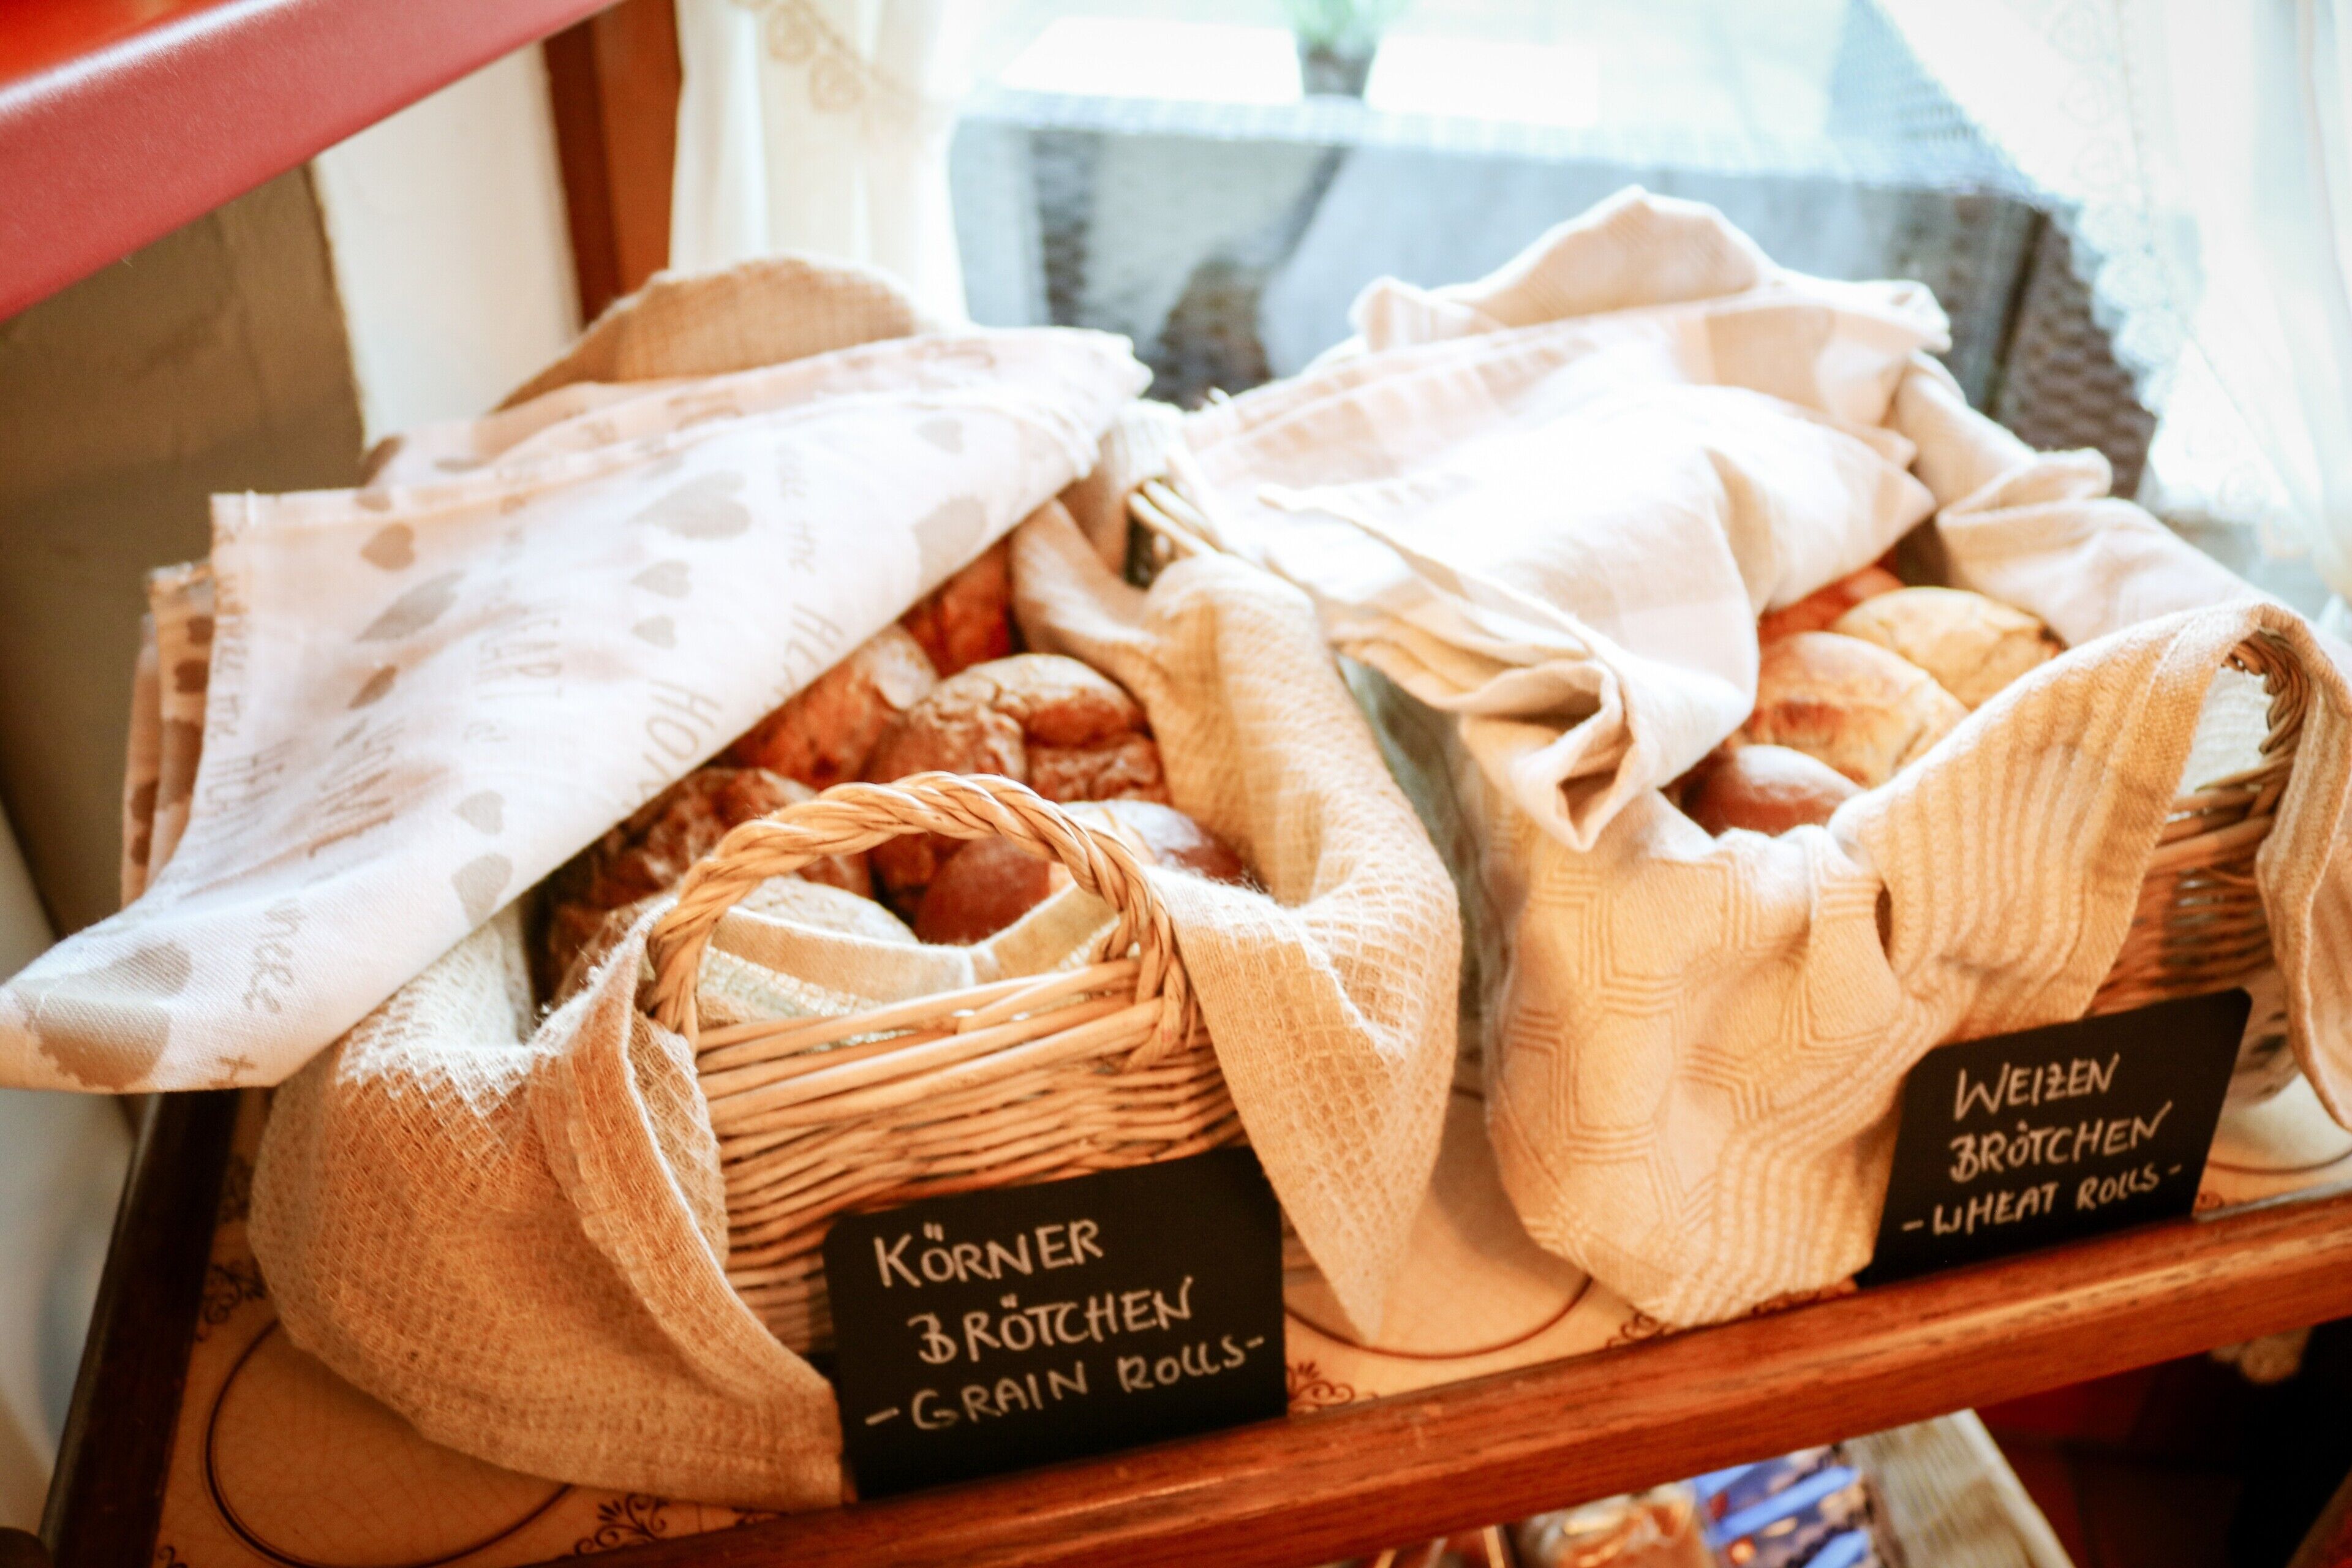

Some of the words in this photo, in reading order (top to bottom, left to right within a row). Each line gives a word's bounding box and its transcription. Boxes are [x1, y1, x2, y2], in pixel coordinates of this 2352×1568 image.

[1952, 1051, 2121, 1121] WEIZEN
[1948, 1100, 2173, 1183] BRÖTCHEN
[873, 1217, 1104, 1289] KÖRNER
[907, 1275, 1194, 1365] BRÖTCHEN
